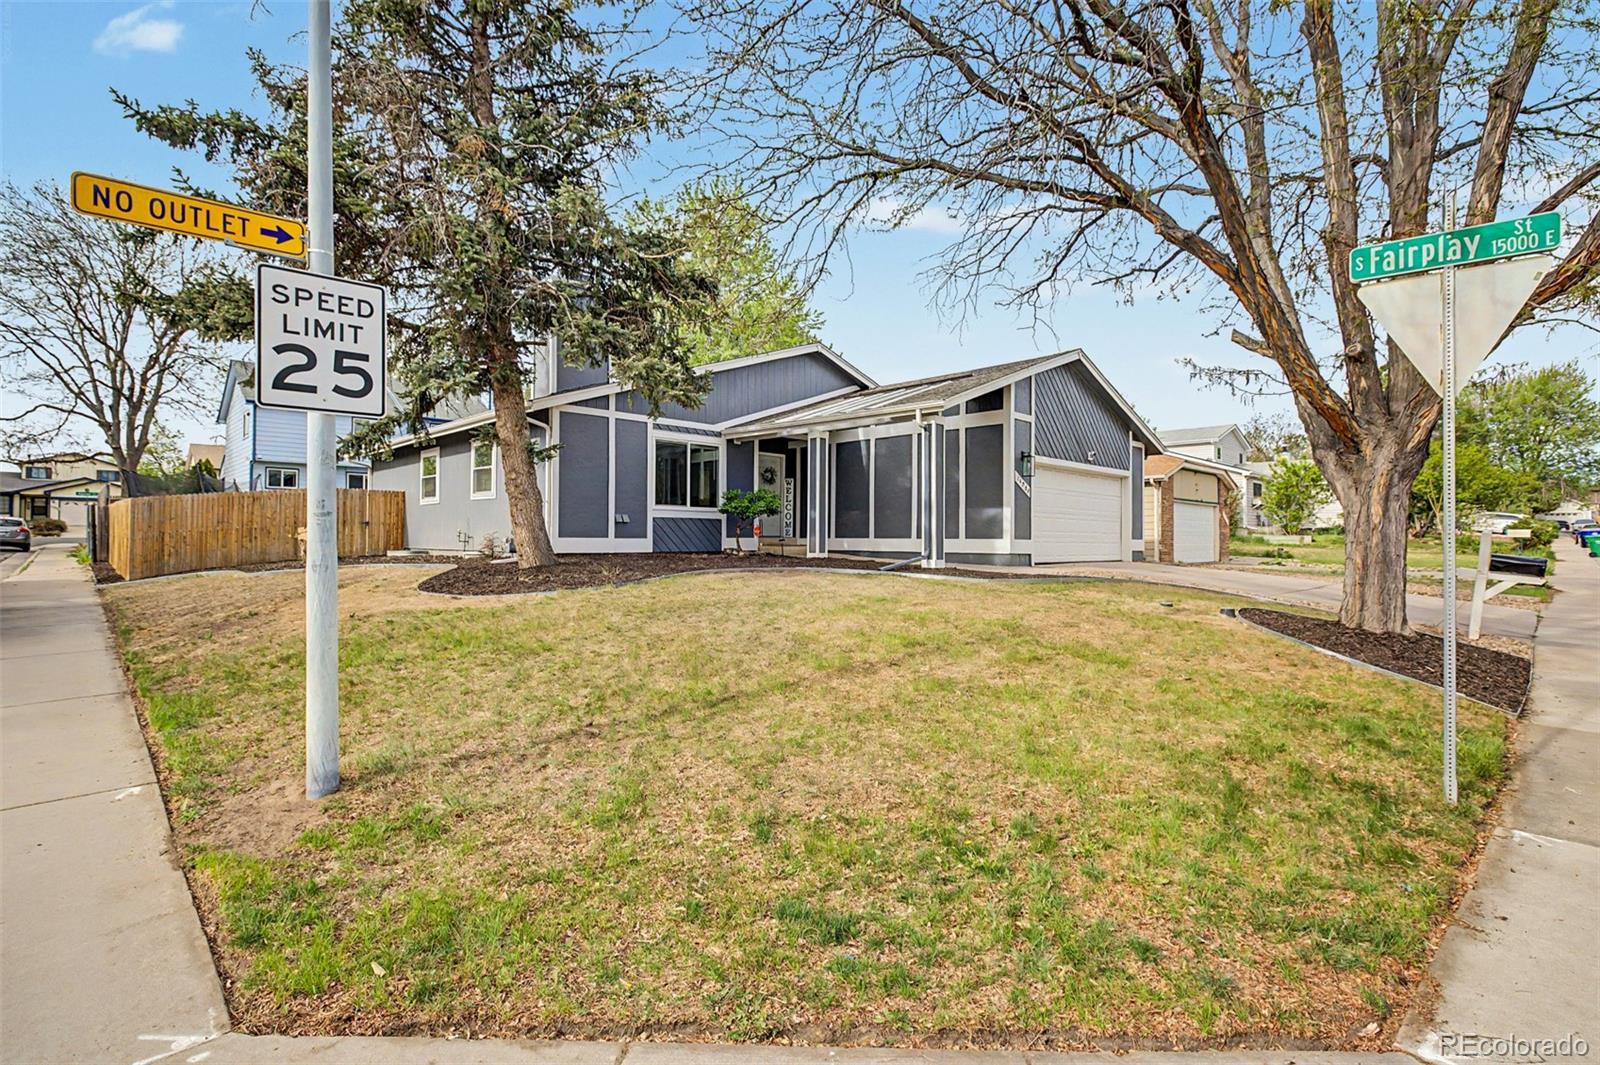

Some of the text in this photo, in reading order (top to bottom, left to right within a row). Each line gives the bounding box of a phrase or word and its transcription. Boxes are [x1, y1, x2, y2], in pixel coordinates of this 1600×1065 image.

[92, 184, 250, 237] NO OUTLET
[1514, 218, 1533, 235] St
[1355, 234, 1481, 274] S Fairplay
[1491, 230, 1555, 255] 15000 E
[271, 284, 374, 319] SPEED
[283, 314, 364, 344] LIMIT
[271, 343, 374, 399] 25
[784, 479, 793, 537] WELCOME
